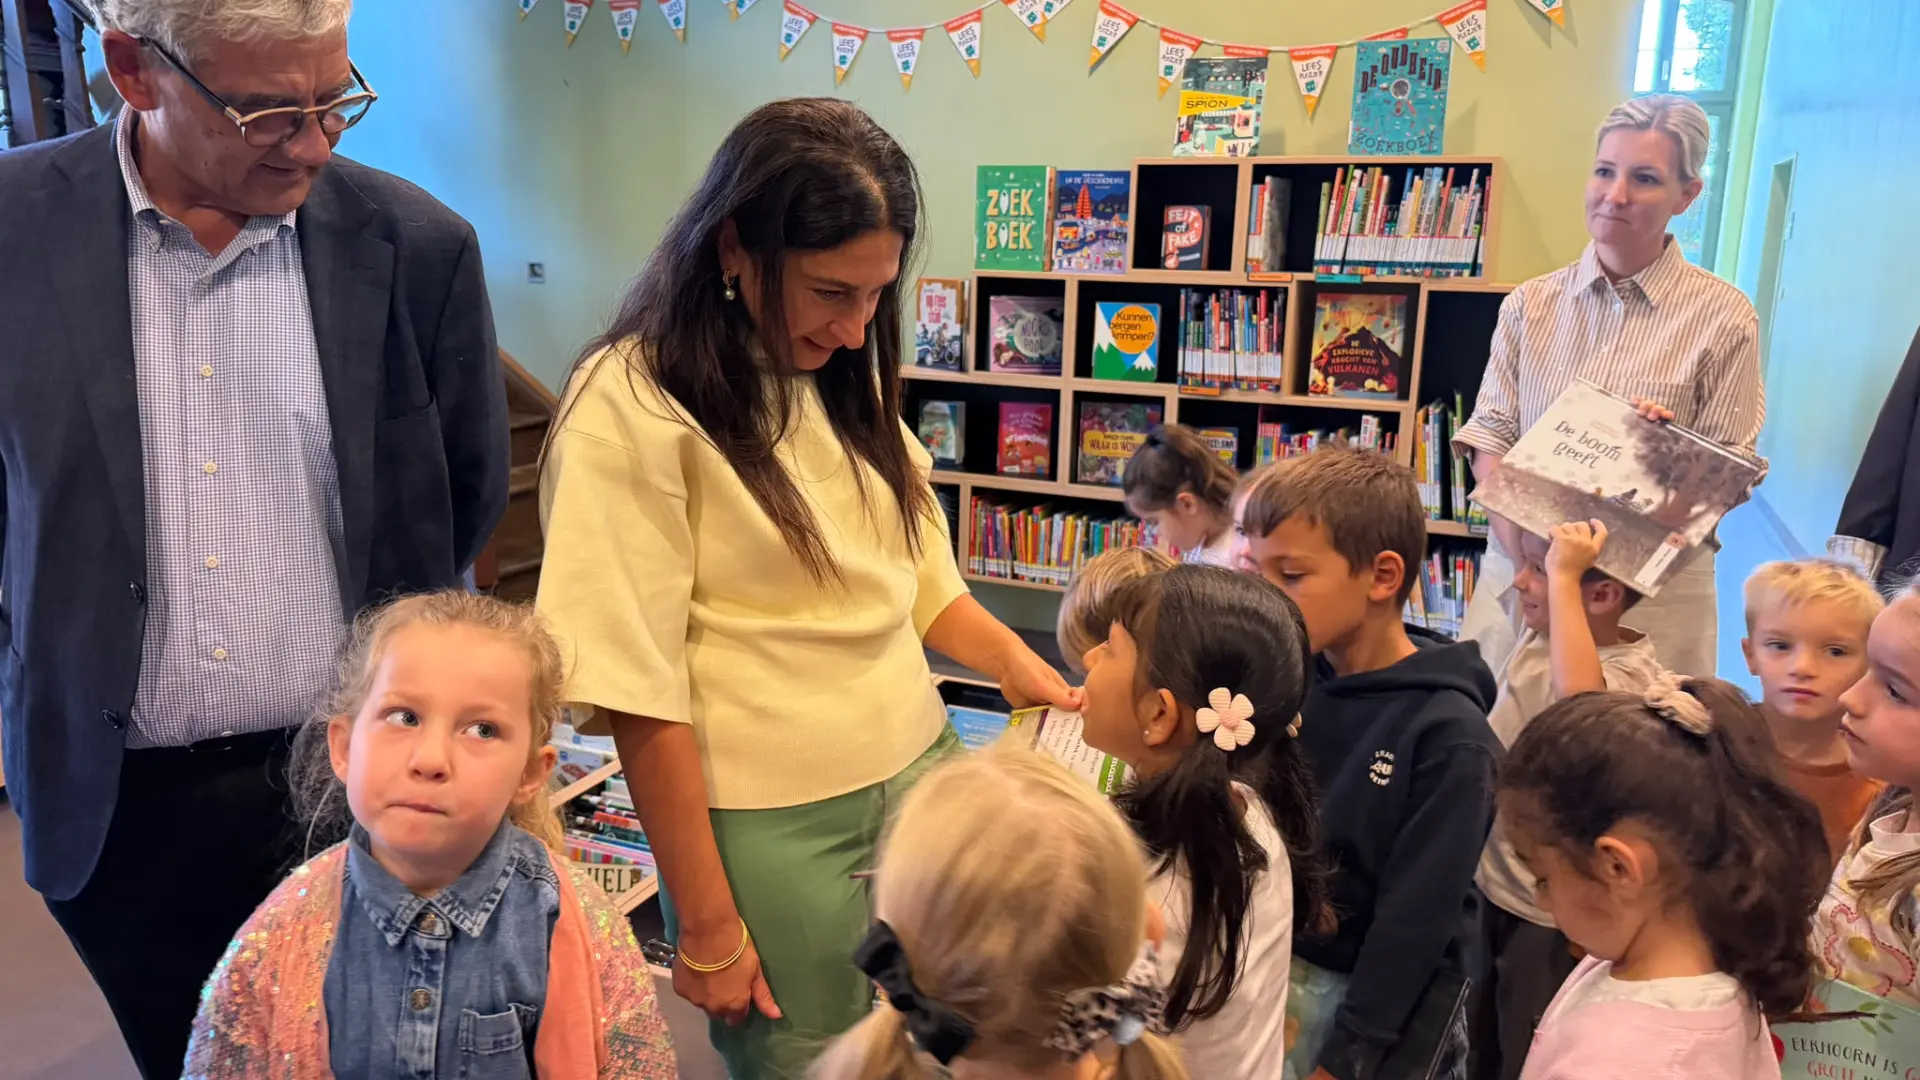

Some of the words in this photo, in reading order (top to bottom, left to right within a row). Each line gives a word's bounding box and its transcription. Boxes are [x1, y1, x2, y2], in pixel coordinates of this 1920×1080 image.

[1102, 18, 1121, 32] LEES
[1456, 14, 1479, 32] LEES
[958, 26, 975, 41] LEES
[1165, 46, 1185, 59] LEES
[1301, 60, 1322, 72] LEES
[1381, 44, 1442, 92] OUDHEID
[1186, 100, 1228, 109] SPION
[1356, 130, 1439, 153] ZOEKBOEK
[986, 189, 1035, 217] ZOEK
[1168, 209, 1199, 223] FEIT
[986, 221, 1033, 251] BOEK
[1168, 230, 1197, 249] FAKE
[1116, 311, 1152, 322] Kunnen
[1110, 322, 1141, 333] bergen
[1332, 348, 1375, 356] EXPLOSIEVE
[1327, 364, 1380, 375] VULKANEN
[1553, 420, 1575, 438] De
[1576, 430, 1622, 461] boom
[1552, 441, 1600, 469] geeft
[1883, 1058, 1899, 1075] IS
